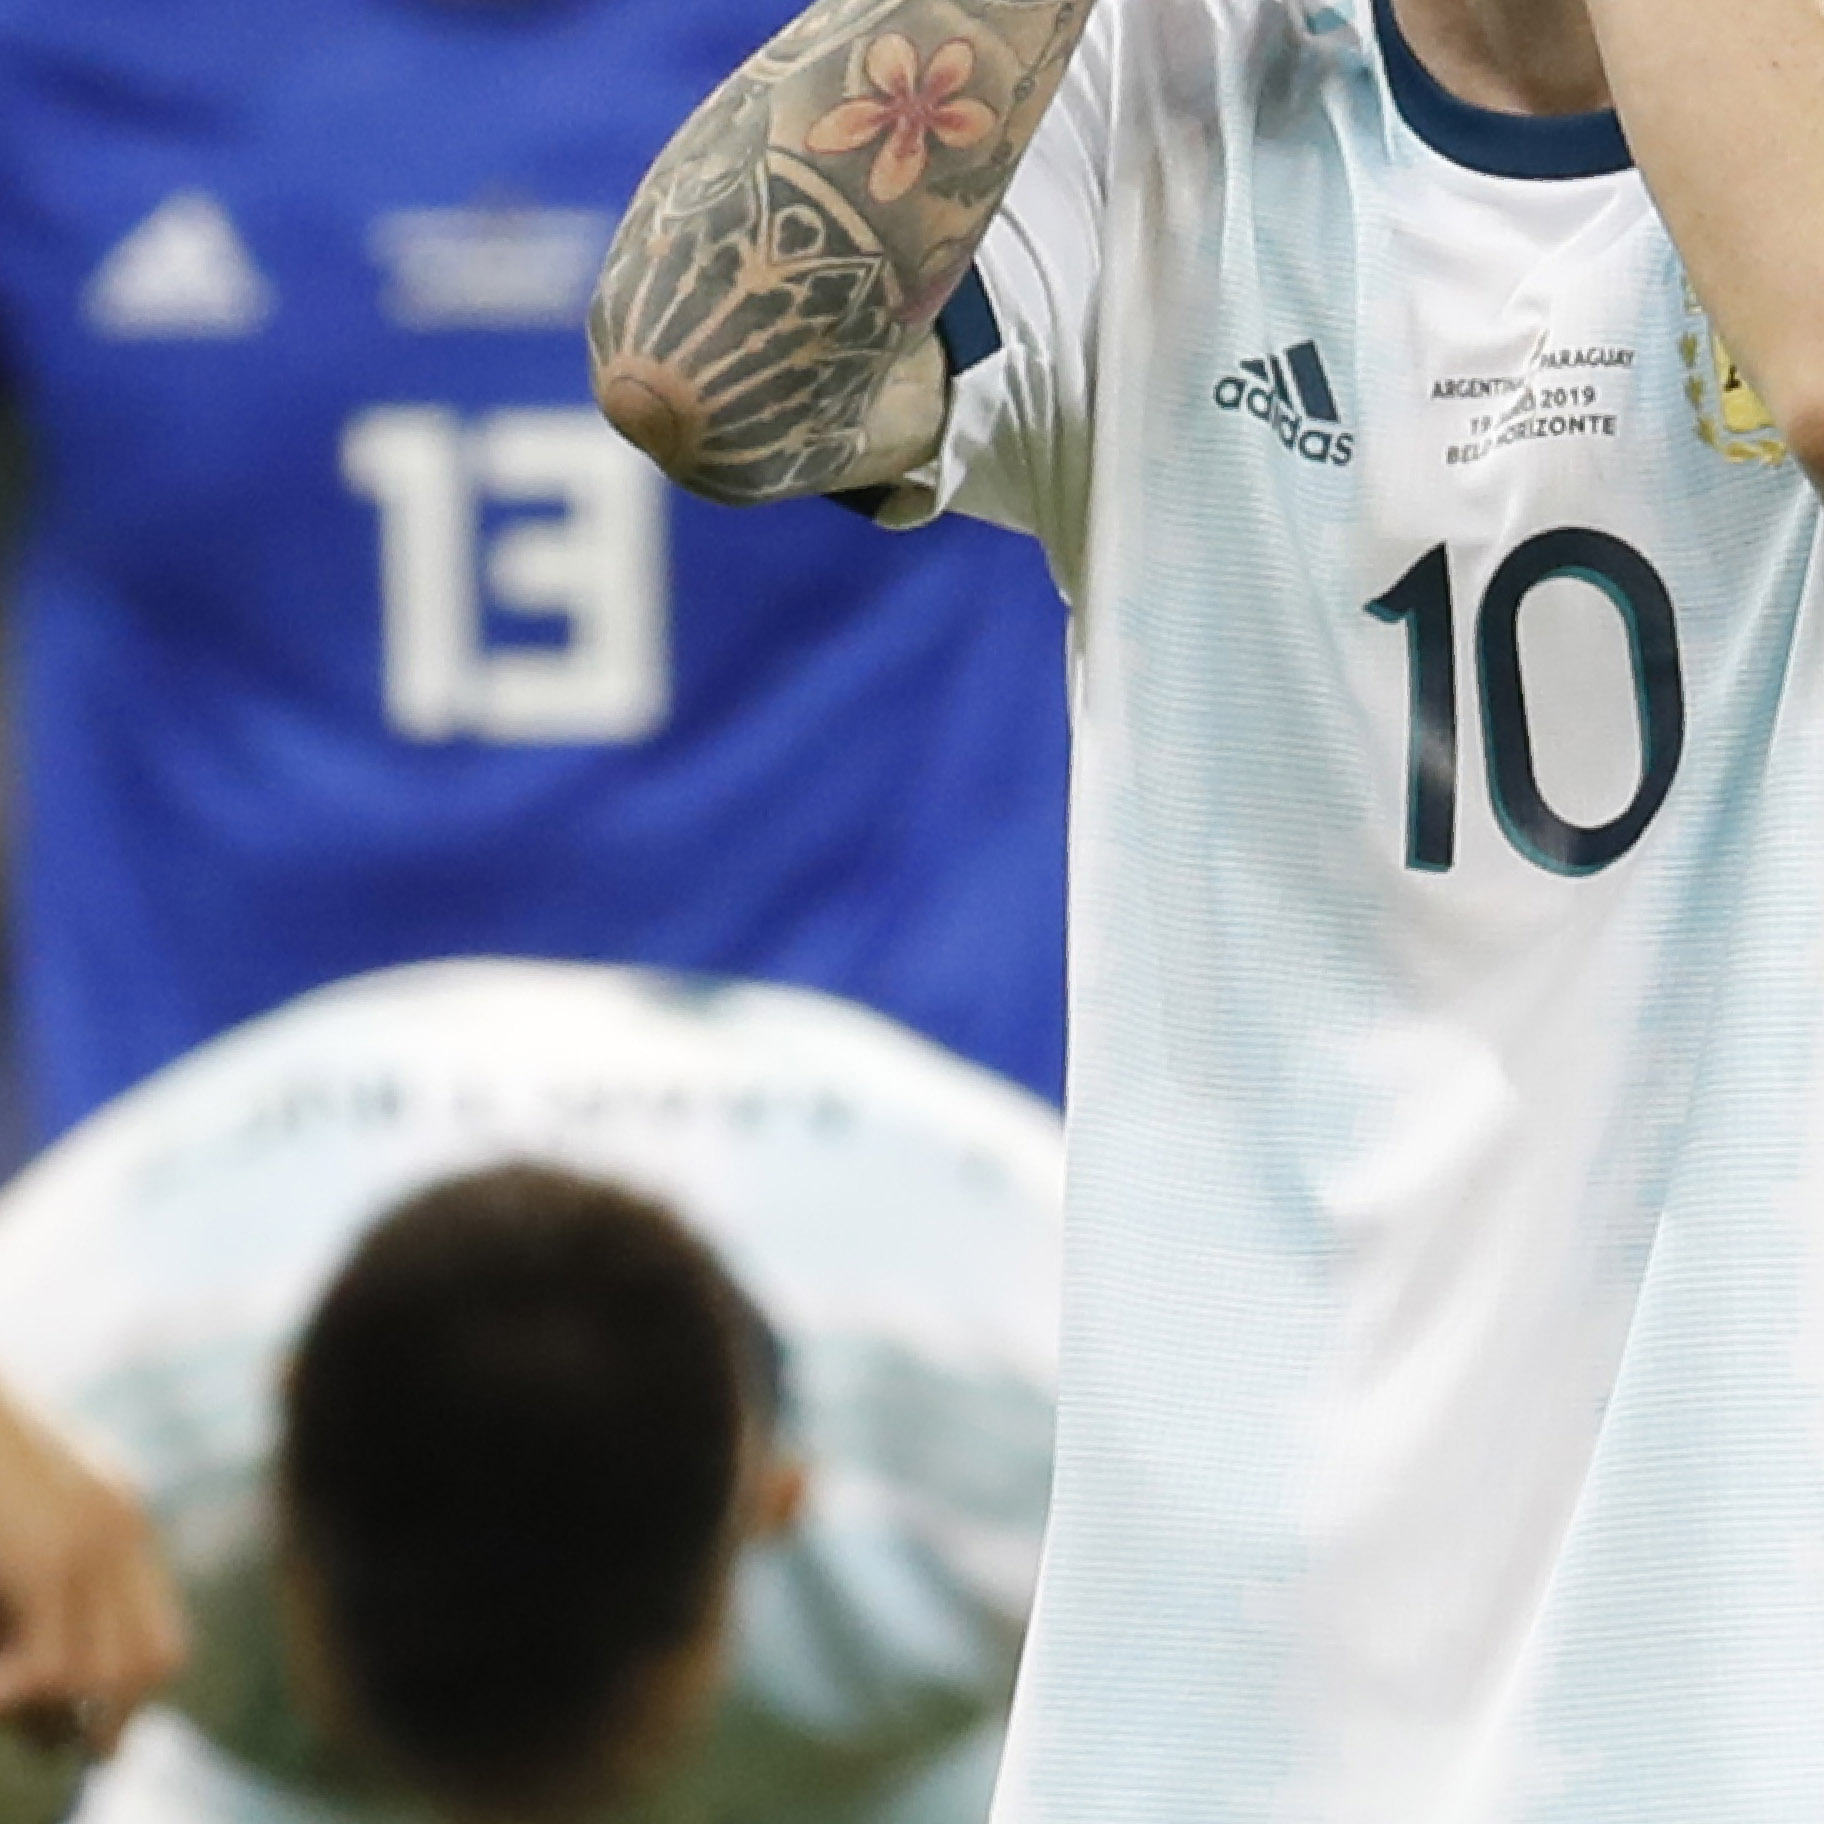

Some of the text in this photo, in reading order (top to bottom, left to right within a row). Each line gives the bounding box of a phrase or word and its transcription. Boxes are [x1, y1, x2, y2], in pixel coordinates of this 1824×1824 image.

[1213, 375, 1354, 466] addas
[1540, 384, 1597, 408] 2019
[339, 402, 670, 743] 13
[1362, 526, 1685, 877] 10
